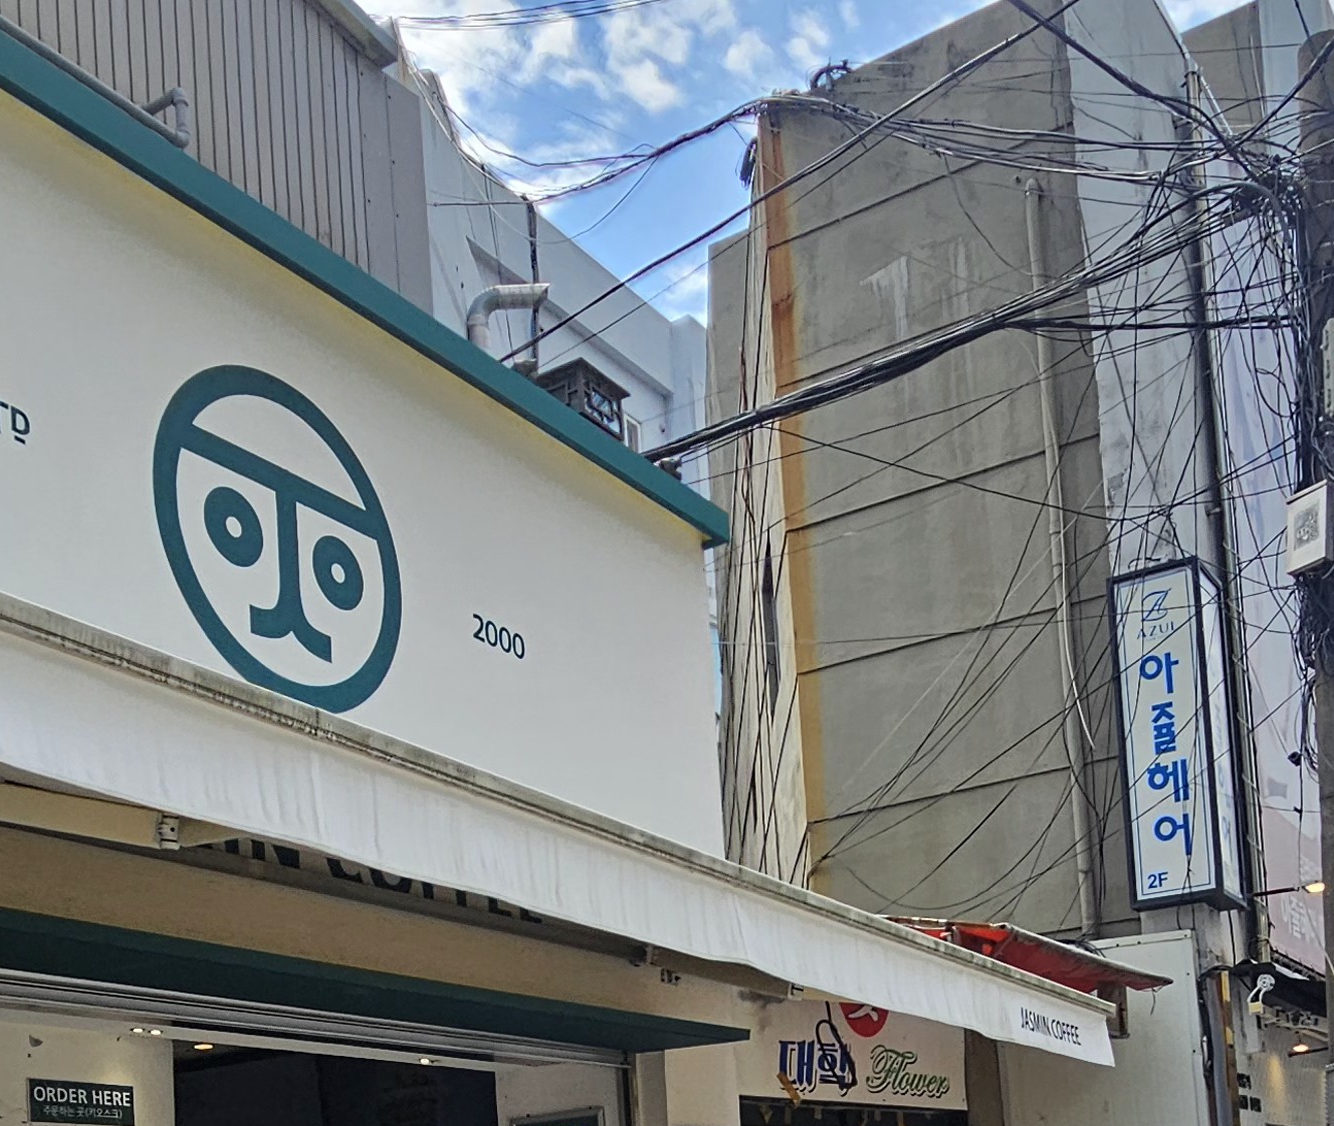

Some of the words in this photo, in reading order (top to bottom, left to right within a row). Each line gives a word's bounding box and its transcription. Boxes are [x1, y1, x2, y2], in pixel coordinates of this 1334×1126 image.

[472, 613, 525, 659] 2000
[1147, 871, 1169, 889] 2F
[1021, 1008, 1050, 1035] JASMIN
[1051, 1019, 1081, 1046] COFFEE
[866, 1045, 950, 1098] Flower
[34, 1086, 87, 1104] ORDER
[93, 1090, 131, 1107] HERE
